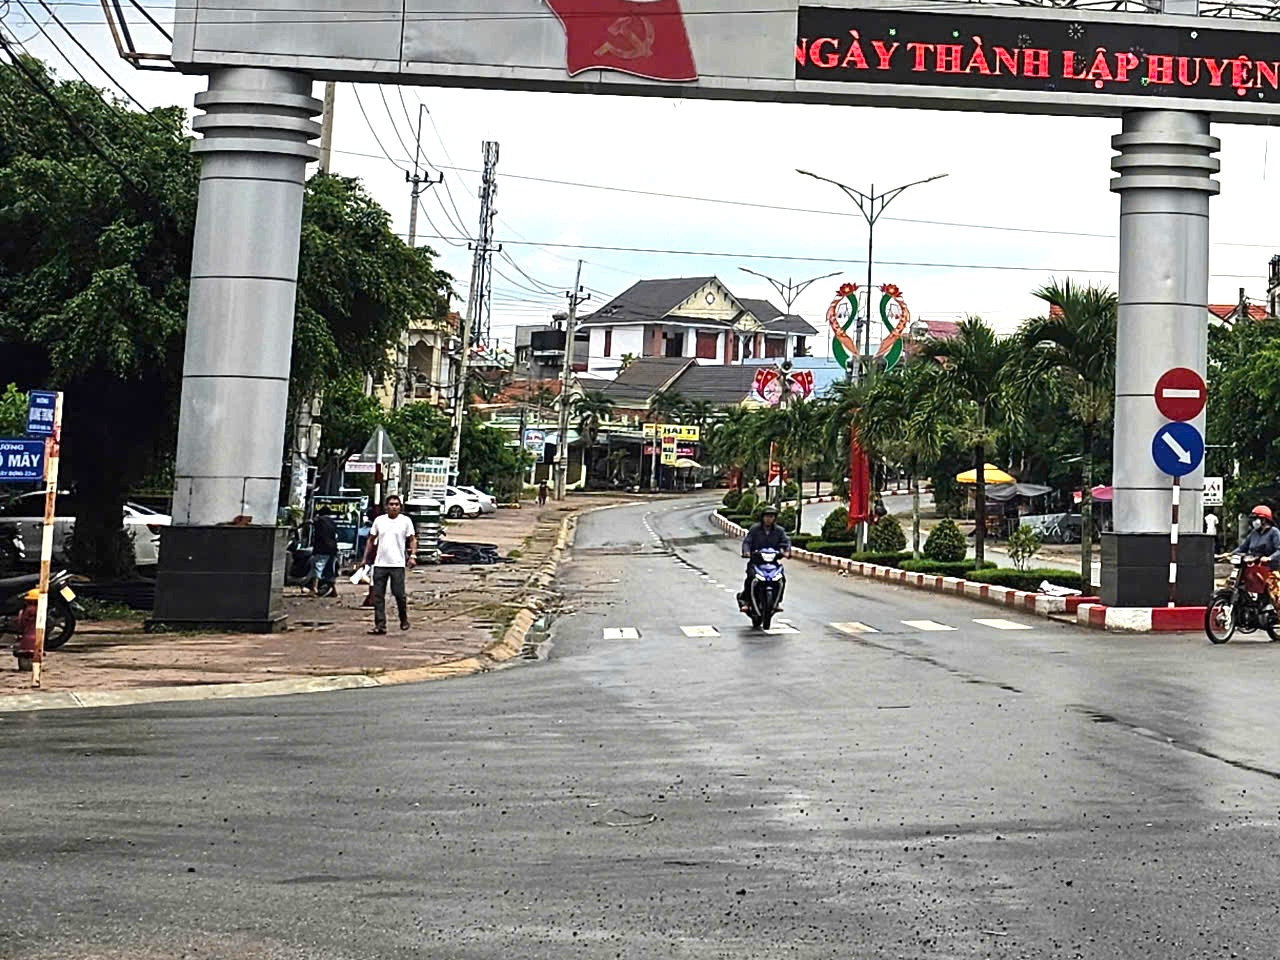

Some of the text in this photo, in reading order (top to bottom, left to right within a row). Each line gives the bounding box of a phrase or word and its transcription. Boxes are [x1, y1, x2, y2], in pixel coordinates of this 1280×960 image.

[907, 35, 1050, 77] THÀNH
[1062, 47, 1139, 89] LẬP
[8, 451, 40, 468] MÂY
